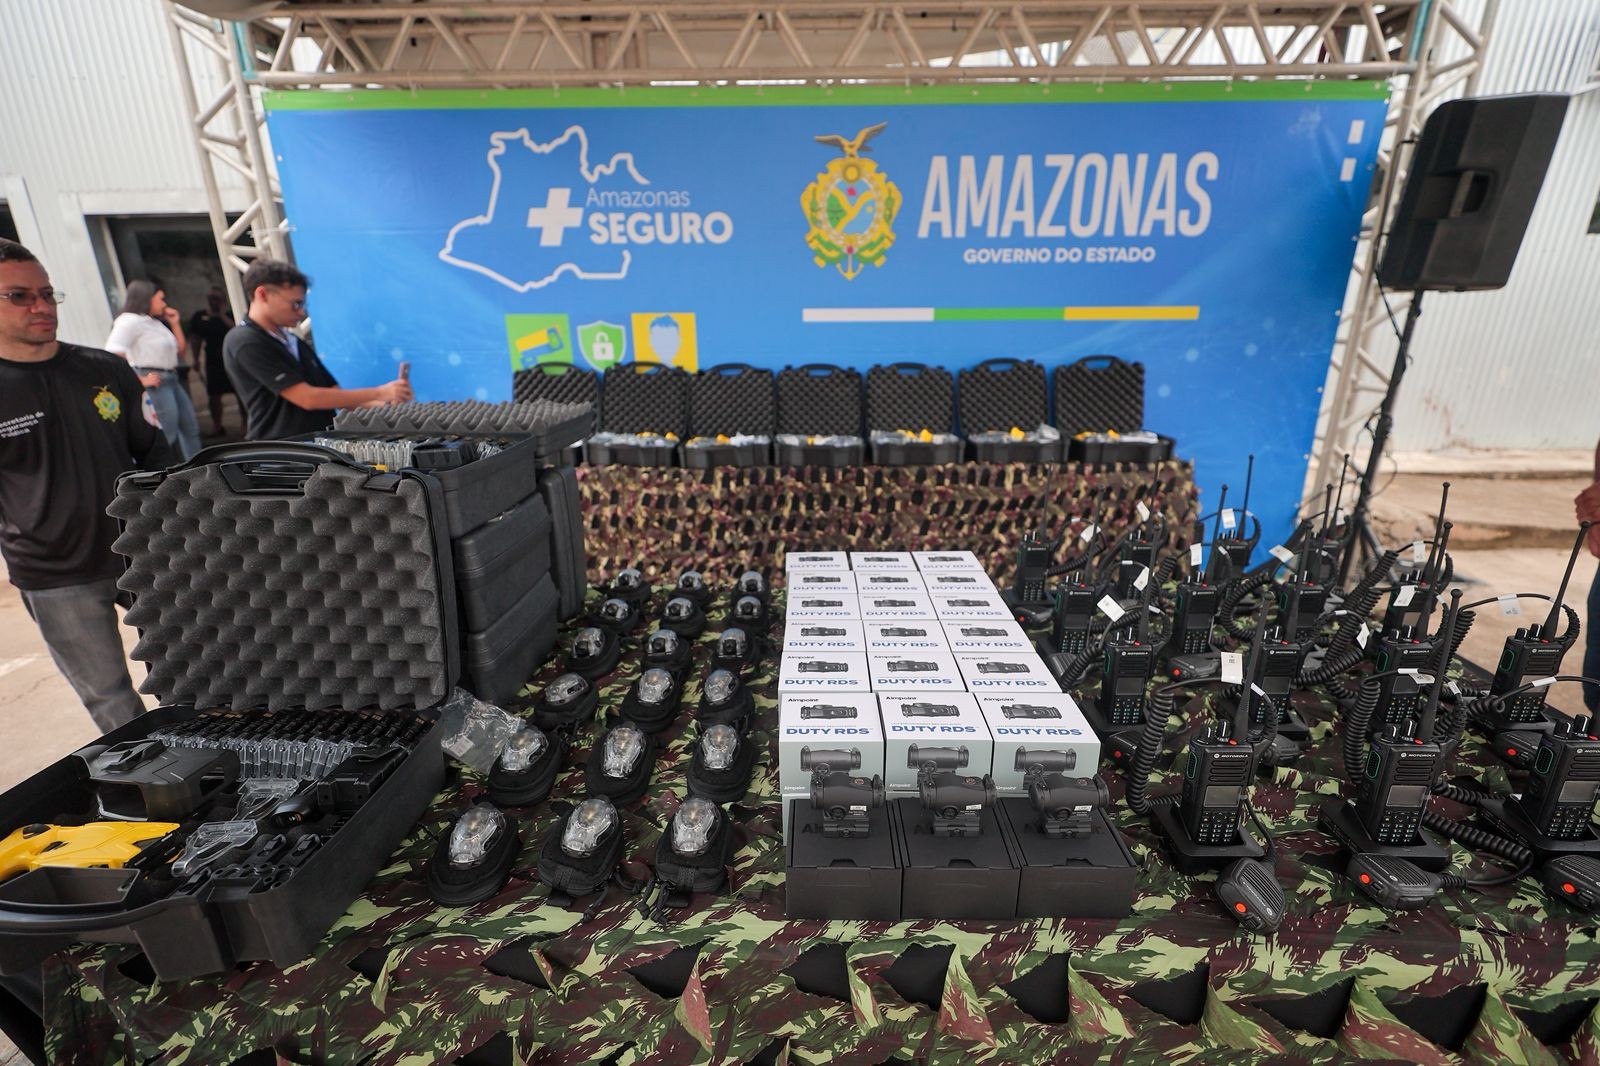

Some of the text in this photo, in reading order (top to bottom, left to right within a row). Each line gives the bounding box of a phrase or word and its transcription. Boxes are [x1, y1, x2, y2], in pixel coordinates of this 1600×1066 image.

[585, 187, 691, 208] Amazonas
[917, 151, 1219, 239] AMAZONAS
[588, 211, 734, 245] SEGURO
[963, 246, 1156, 264] GOVERNO DO ESTADO
